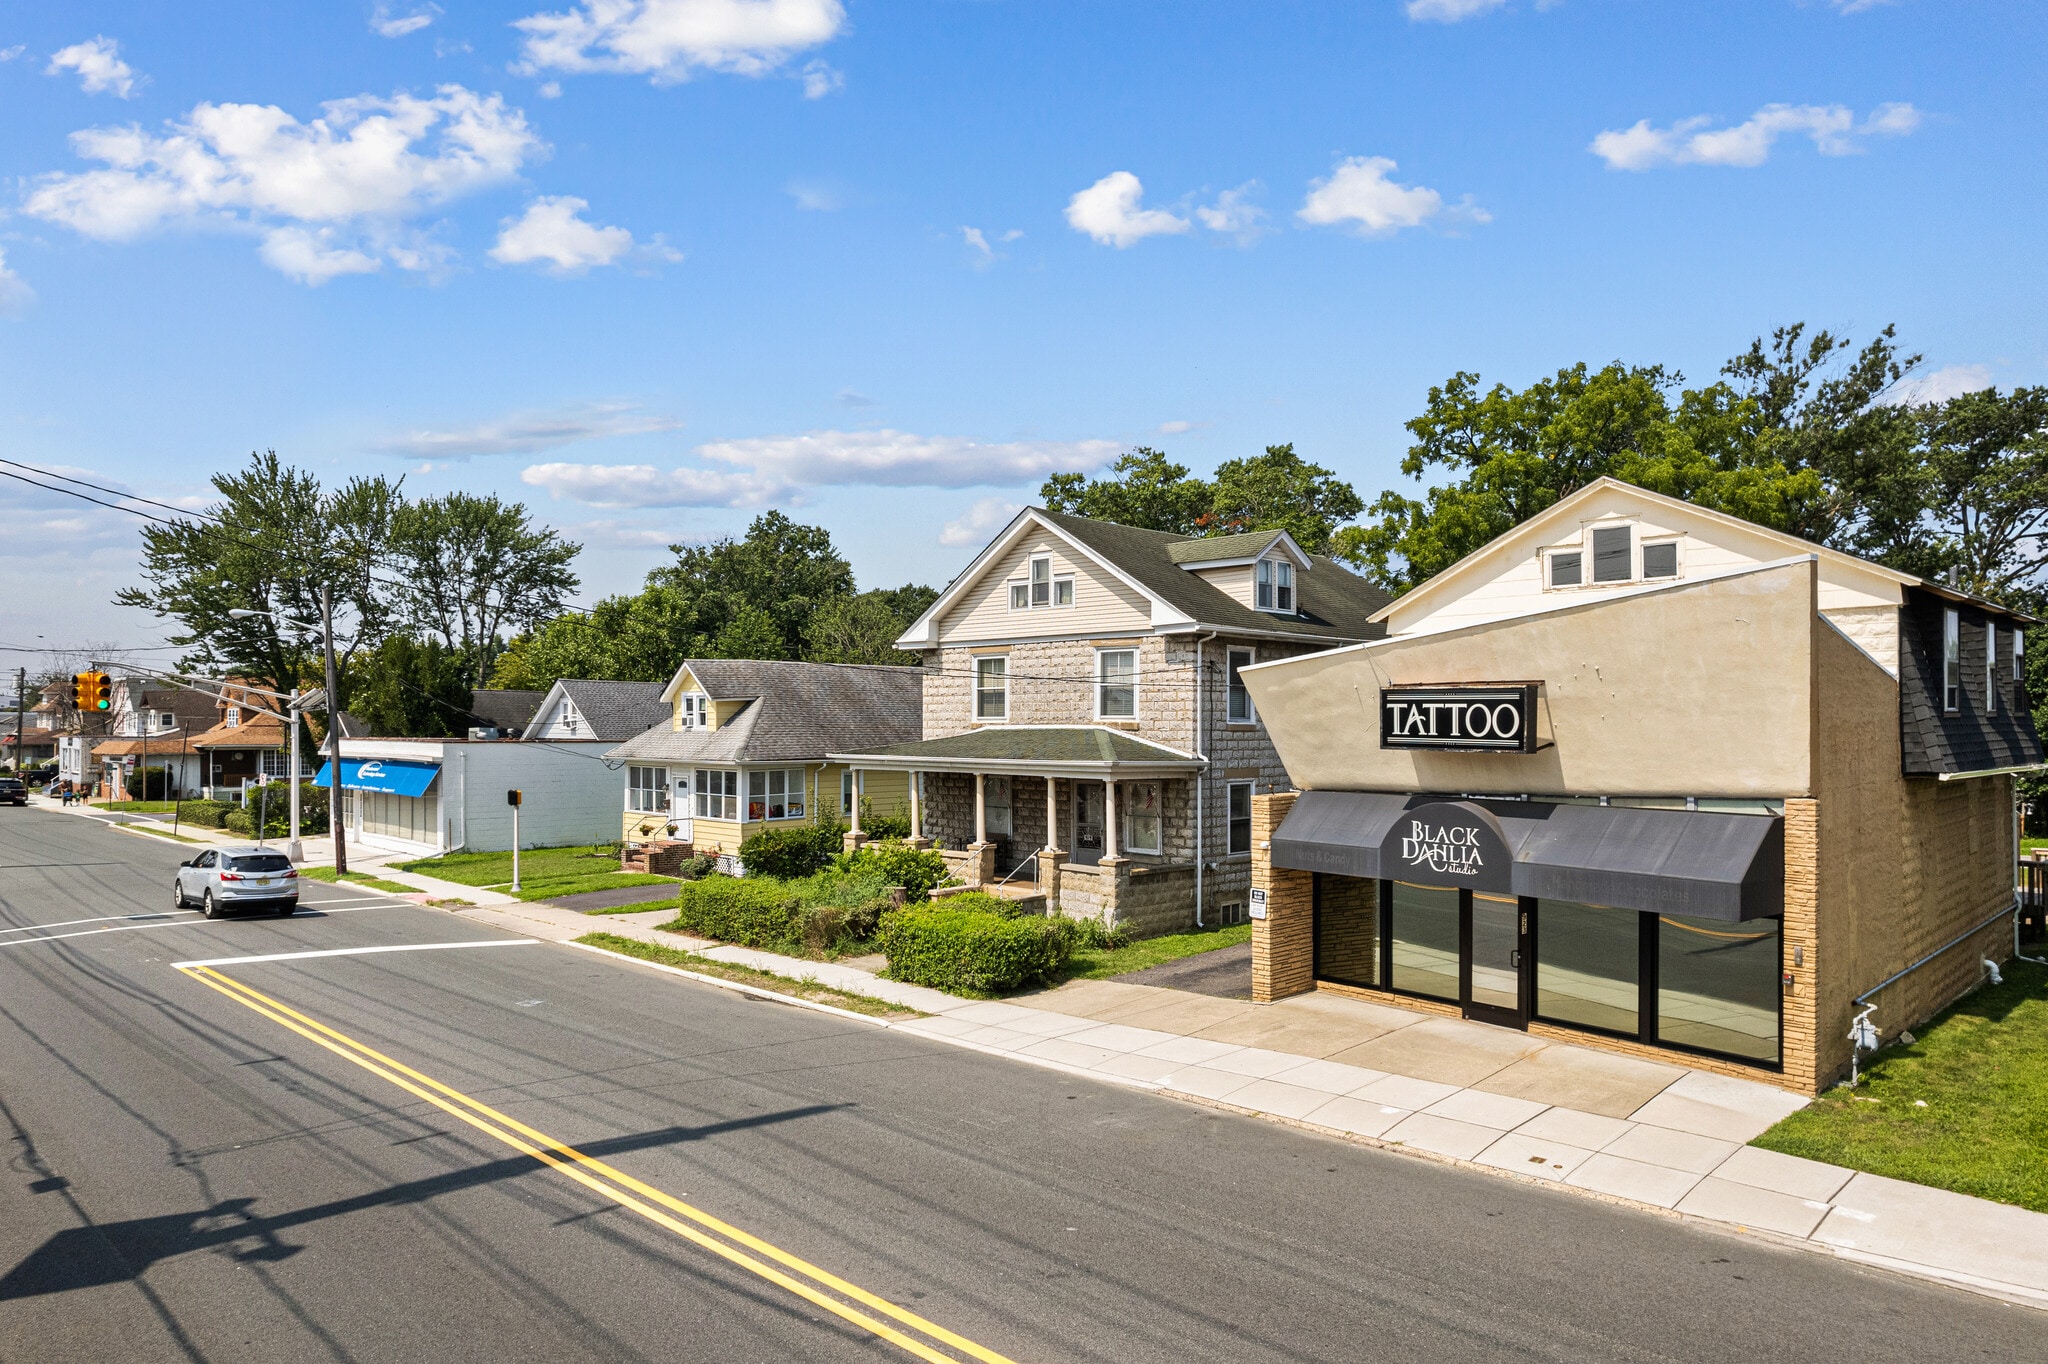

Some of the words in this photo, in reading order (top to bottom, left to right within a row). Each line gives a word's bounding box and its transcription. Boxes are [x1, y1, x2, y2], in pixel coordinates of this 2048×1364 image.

[1386, 703, 1520, 738] TATTOO
[1411, 820, 1480, 847] BLACK
[1401, 836, 1484, 872] DAHLIA
[1447, 862, 1479, 875] studio
